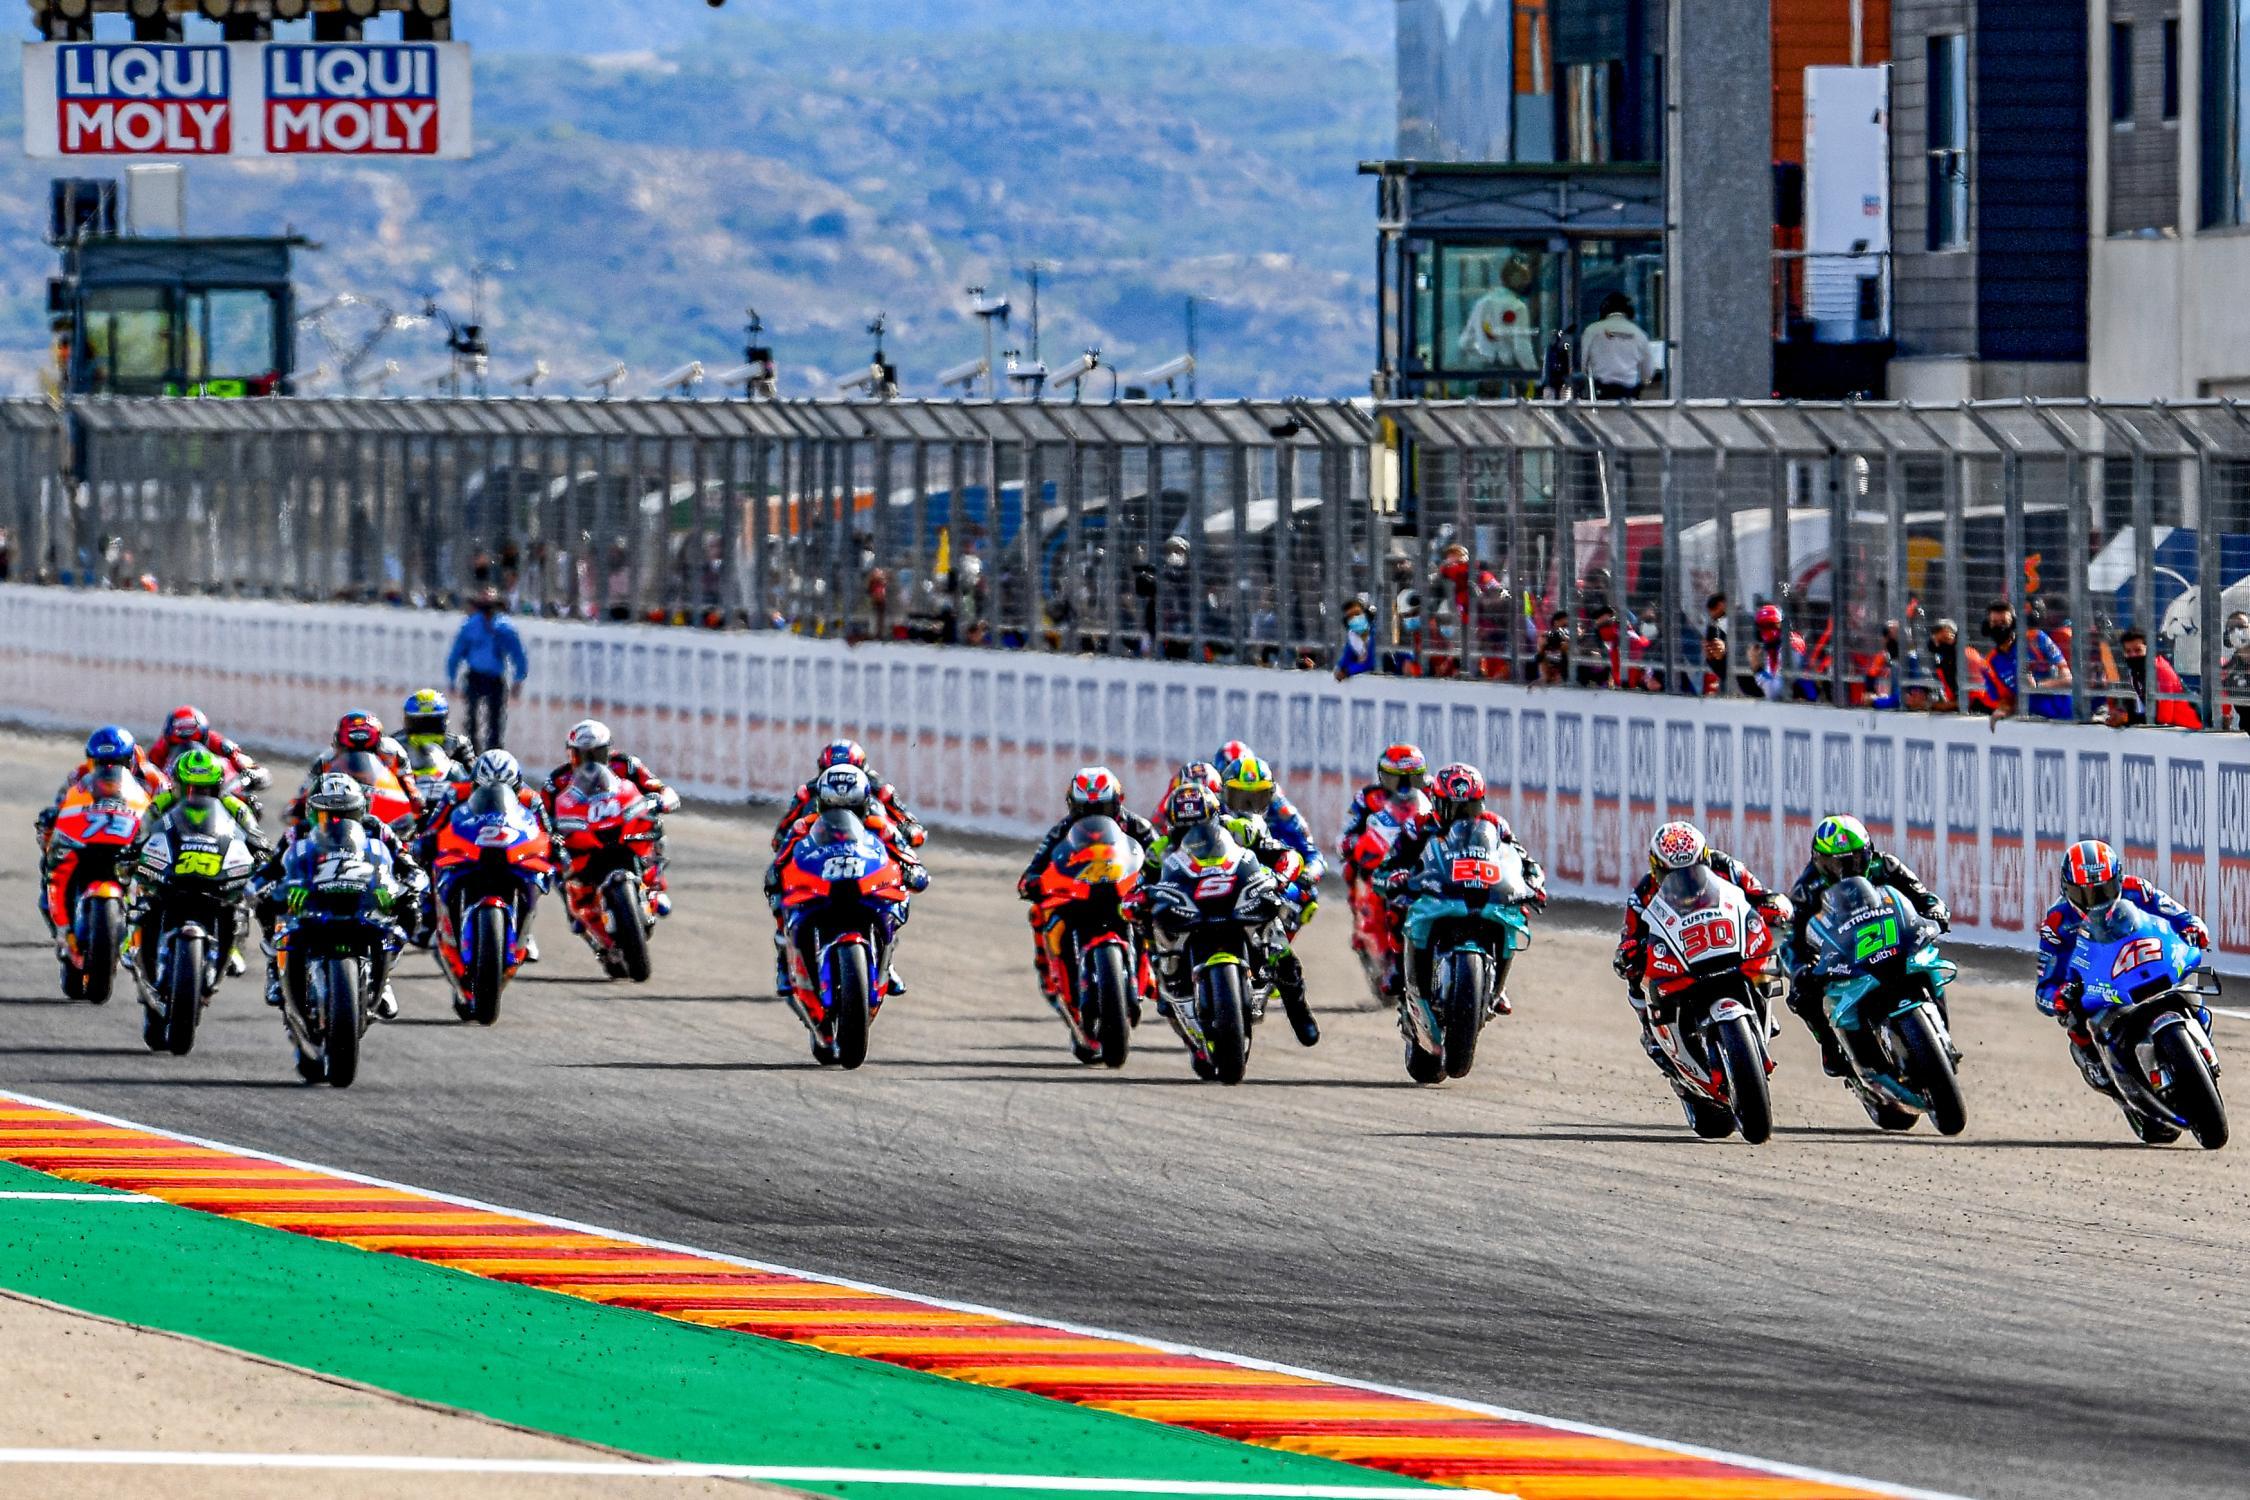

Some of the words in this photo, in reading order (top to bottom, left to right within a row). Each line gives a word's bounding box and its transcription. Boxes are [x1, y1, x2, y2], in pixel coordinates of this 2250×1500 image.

[65, 48, 223, 98] LIQUI
[272, 48, 430, 98] LIQUI
[66, 102, 227, 150] MOLY
[272, 102, 434, 150] MOLY
[2123, 762, 2156, 845] LIQUI
[2170, 765, 2204, 849] LIQUI
[2219, 770, 2250, 854] LIQU
[82, 813, 136, 838] 73
[175, 851, 224, 877] 35
[313, 860, 375, 883] 12
[1669, 852, 1694, 864] Arai
[1680, 918, 1736, 960] 30
[1681, 911, 1723, 927] CUSTOM
[1837, 907, 1895, 935] PETRONAS
[1855, 916, 1900, 963] 21
[2111, 937, 2163, 980] 42
[2087, 984, 2118, 998] SUZUKI
